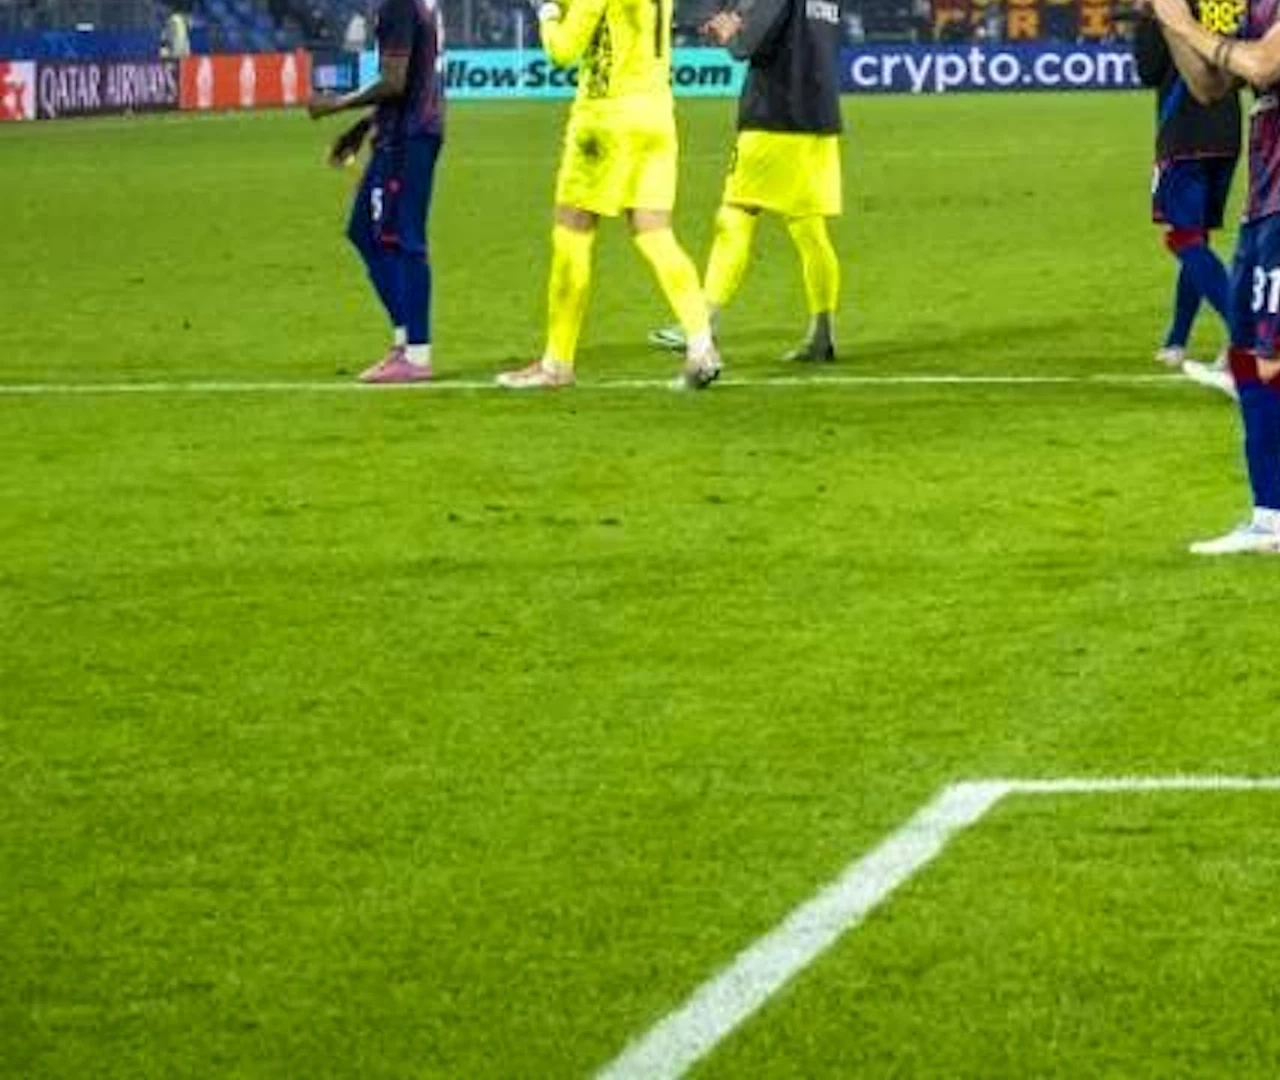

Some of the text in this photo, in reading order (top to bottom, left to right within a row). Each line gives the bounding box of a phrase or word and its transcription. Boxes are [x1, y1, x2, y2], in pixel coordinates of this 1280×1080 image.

[39, 61, 178, 114] QATAR AIRWAYS
[850, 46, 1141, 93] crypto.com
